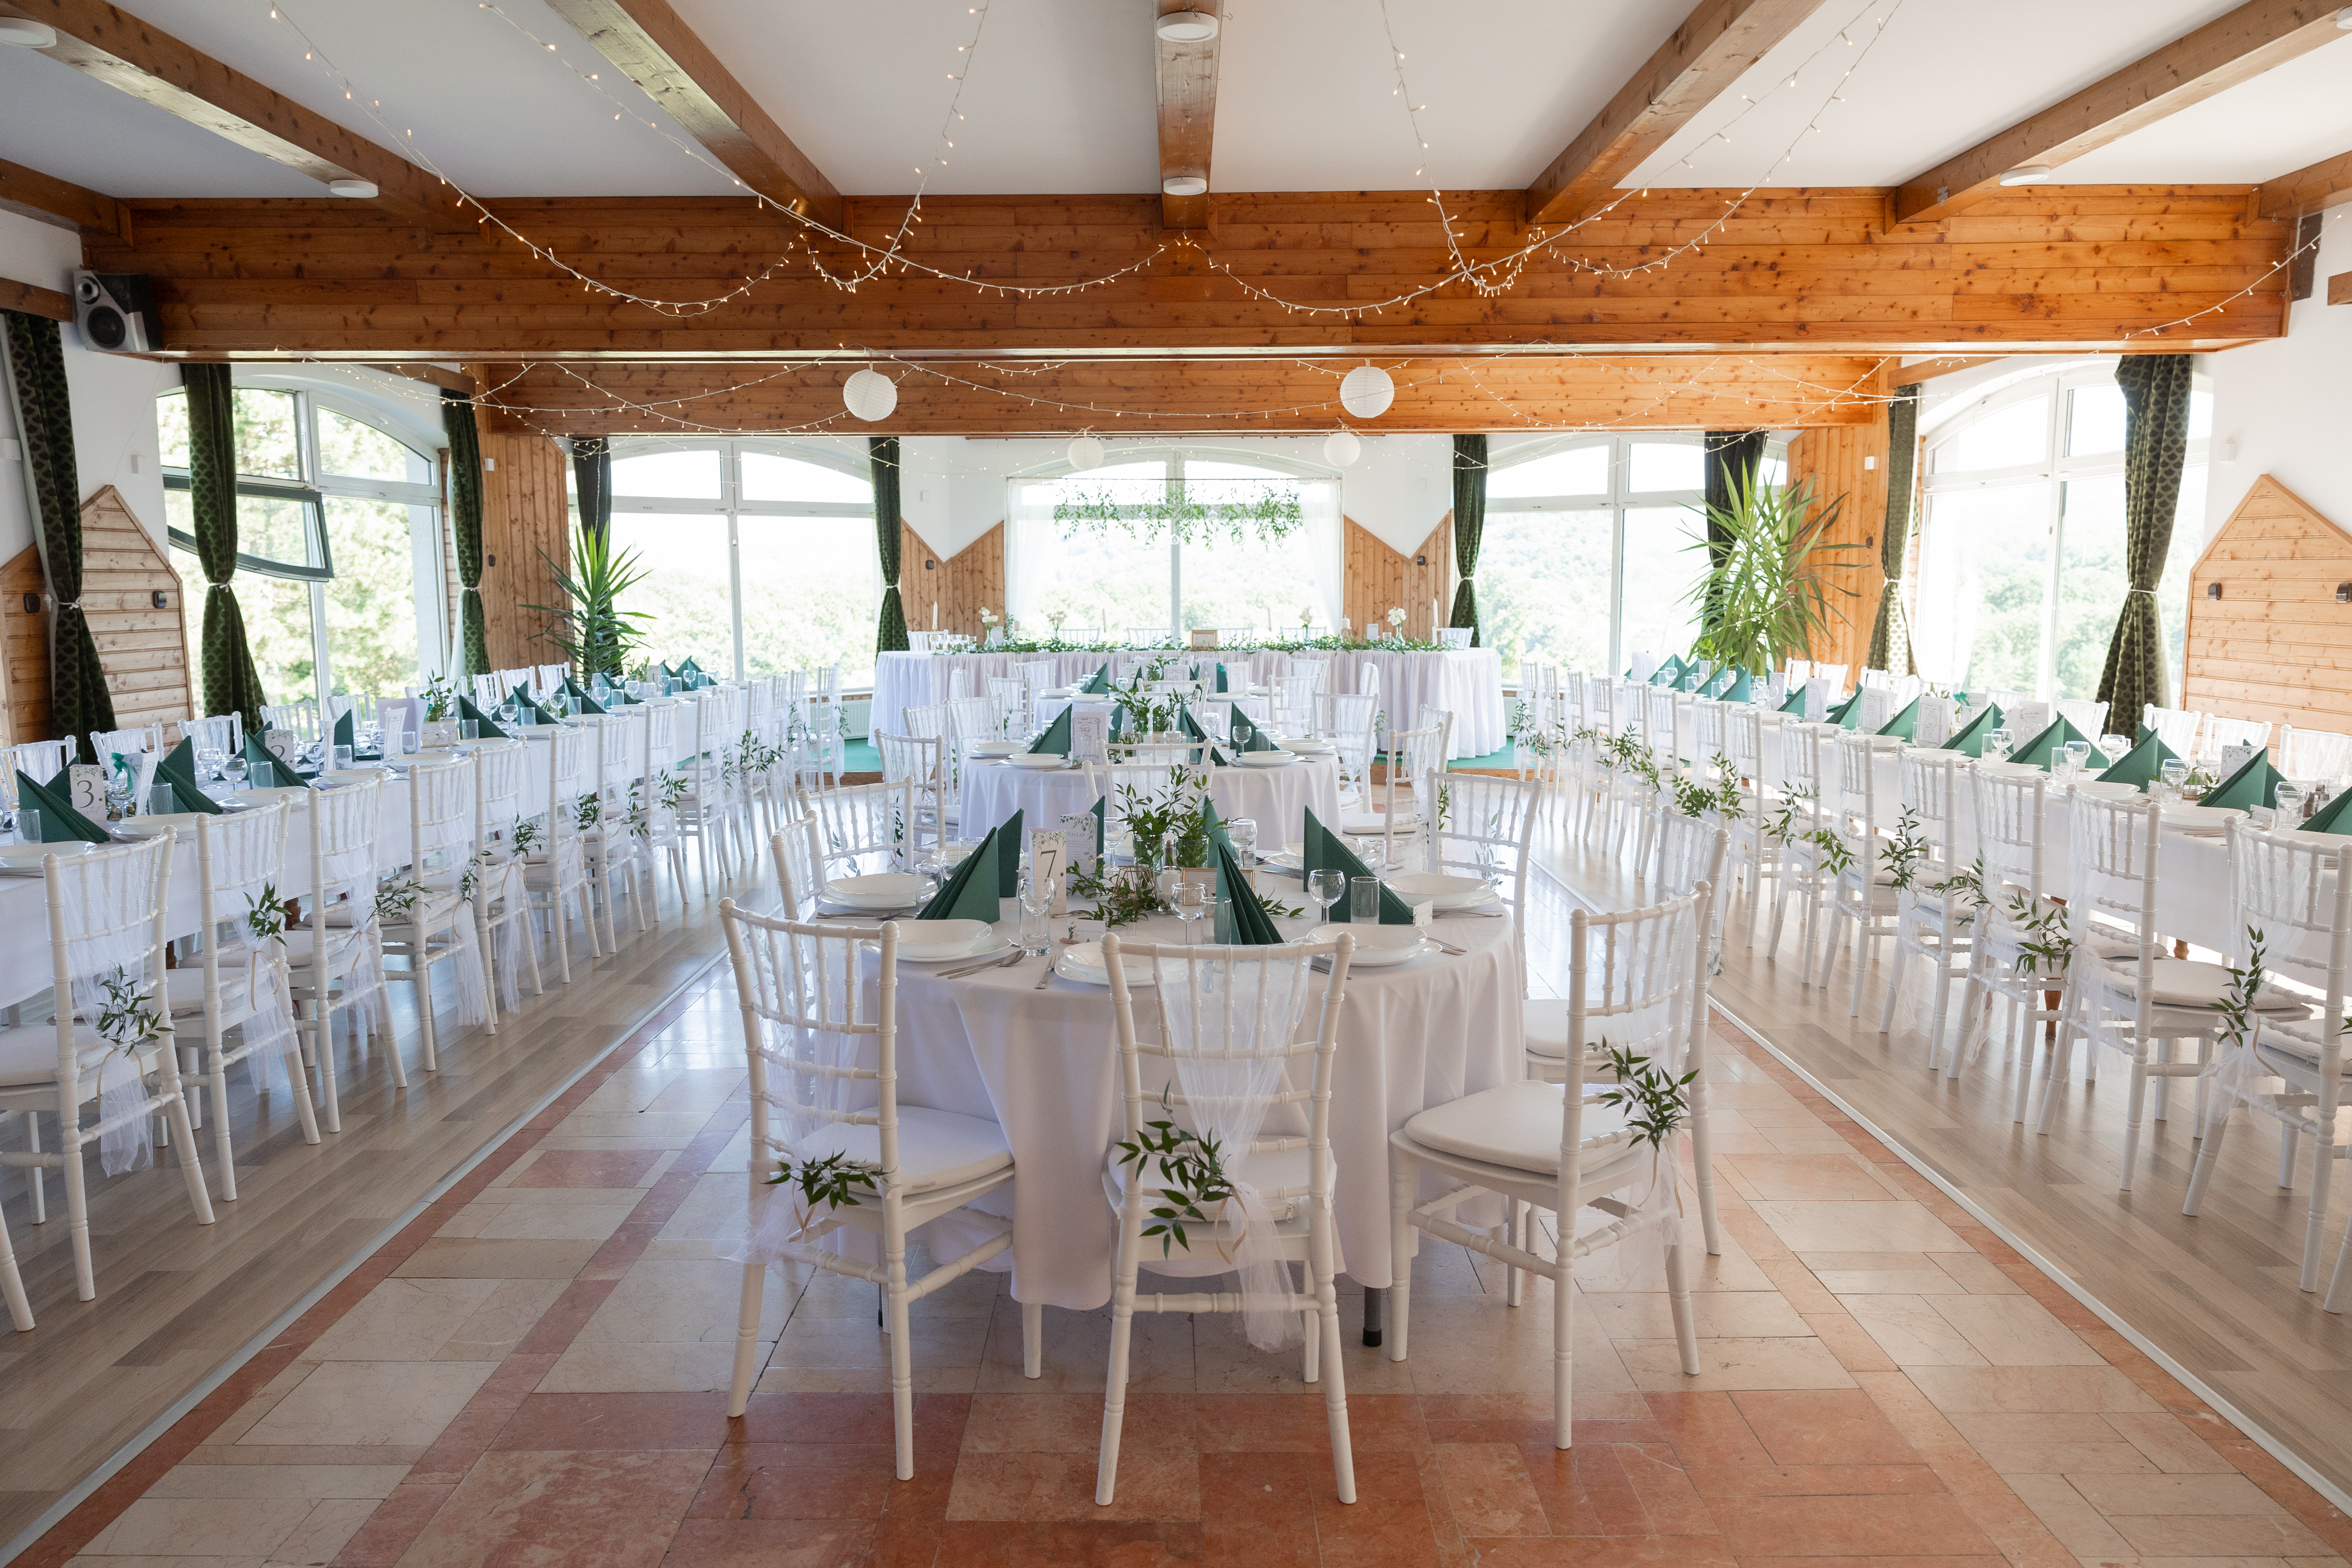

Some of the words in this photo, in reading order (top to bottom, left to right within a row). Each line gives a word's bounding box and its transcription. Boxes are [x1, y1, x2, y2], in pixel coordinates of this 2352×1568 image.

[271, 745, 293, 763] 2.
[77, 780, 103, 808] 3.
[1040, 850, 1064, 883] 7.
